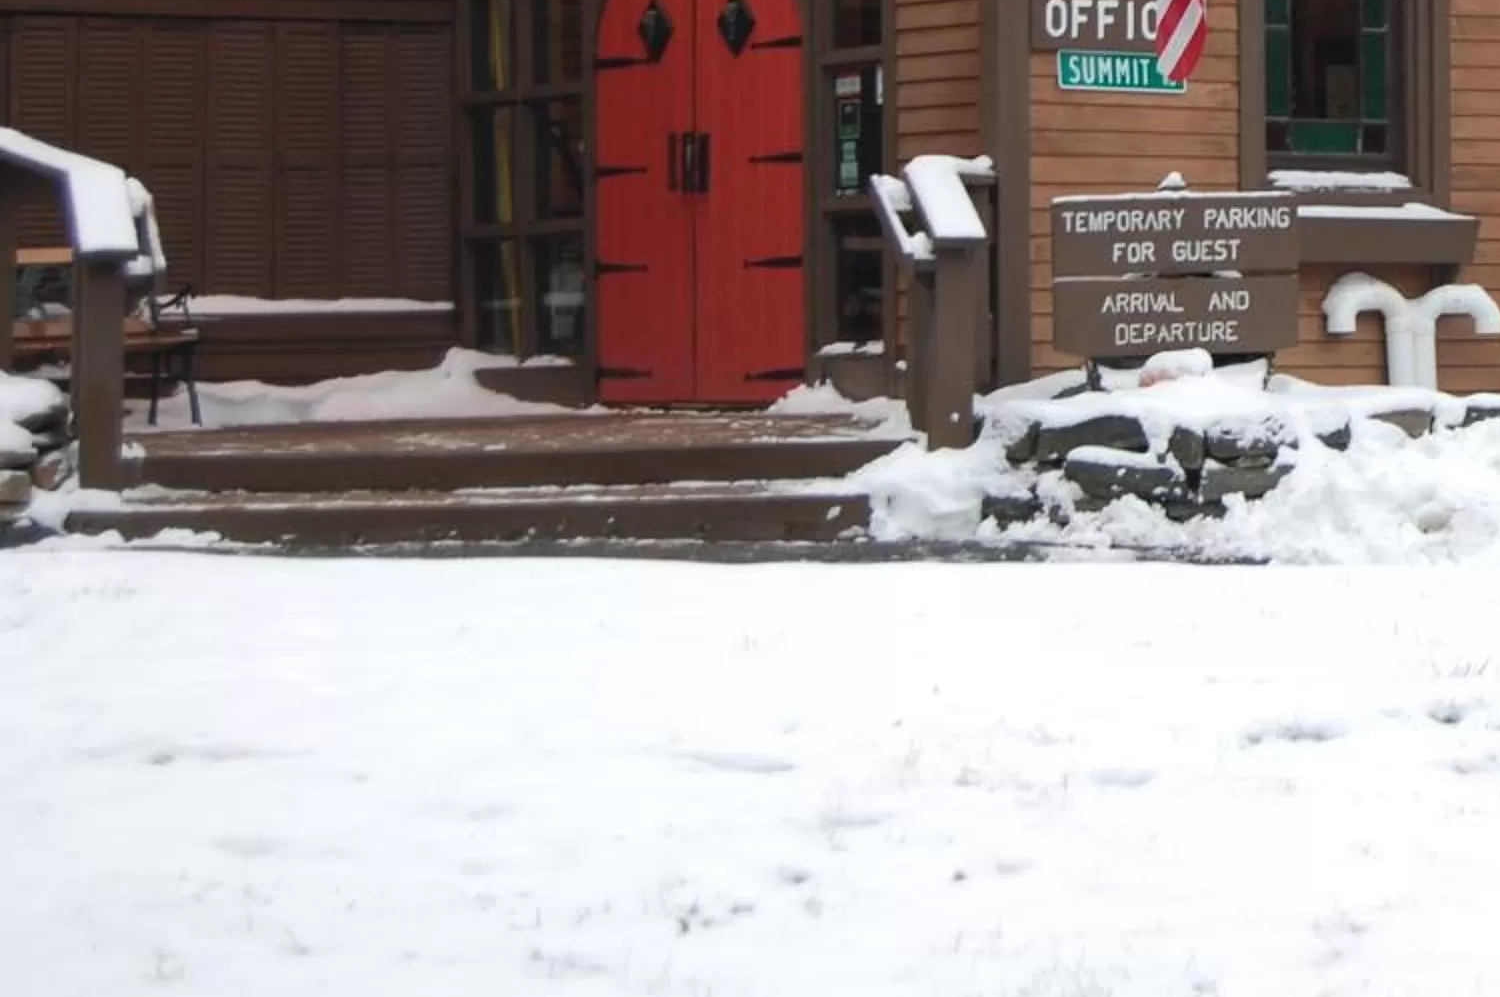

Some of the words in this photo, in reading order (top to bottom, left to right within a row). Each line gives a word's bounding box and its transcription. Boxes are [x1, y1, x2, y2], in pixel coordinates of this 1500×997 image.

[1068, 55, 1151, 86] SUMMIT
[1063, 209, 1186, 233] TEMPORARY
[1204, 206, 1291, 230] PARKING
[1113, 241, 1156, 263] FOR
[1172, 239, 1241, 262] GUEST
[1102, 293, 1185, 314] ARRIVAL
[1209, 290, 1250, 311] AND
[1115, 321, 1239, 345] DEPARTURE
